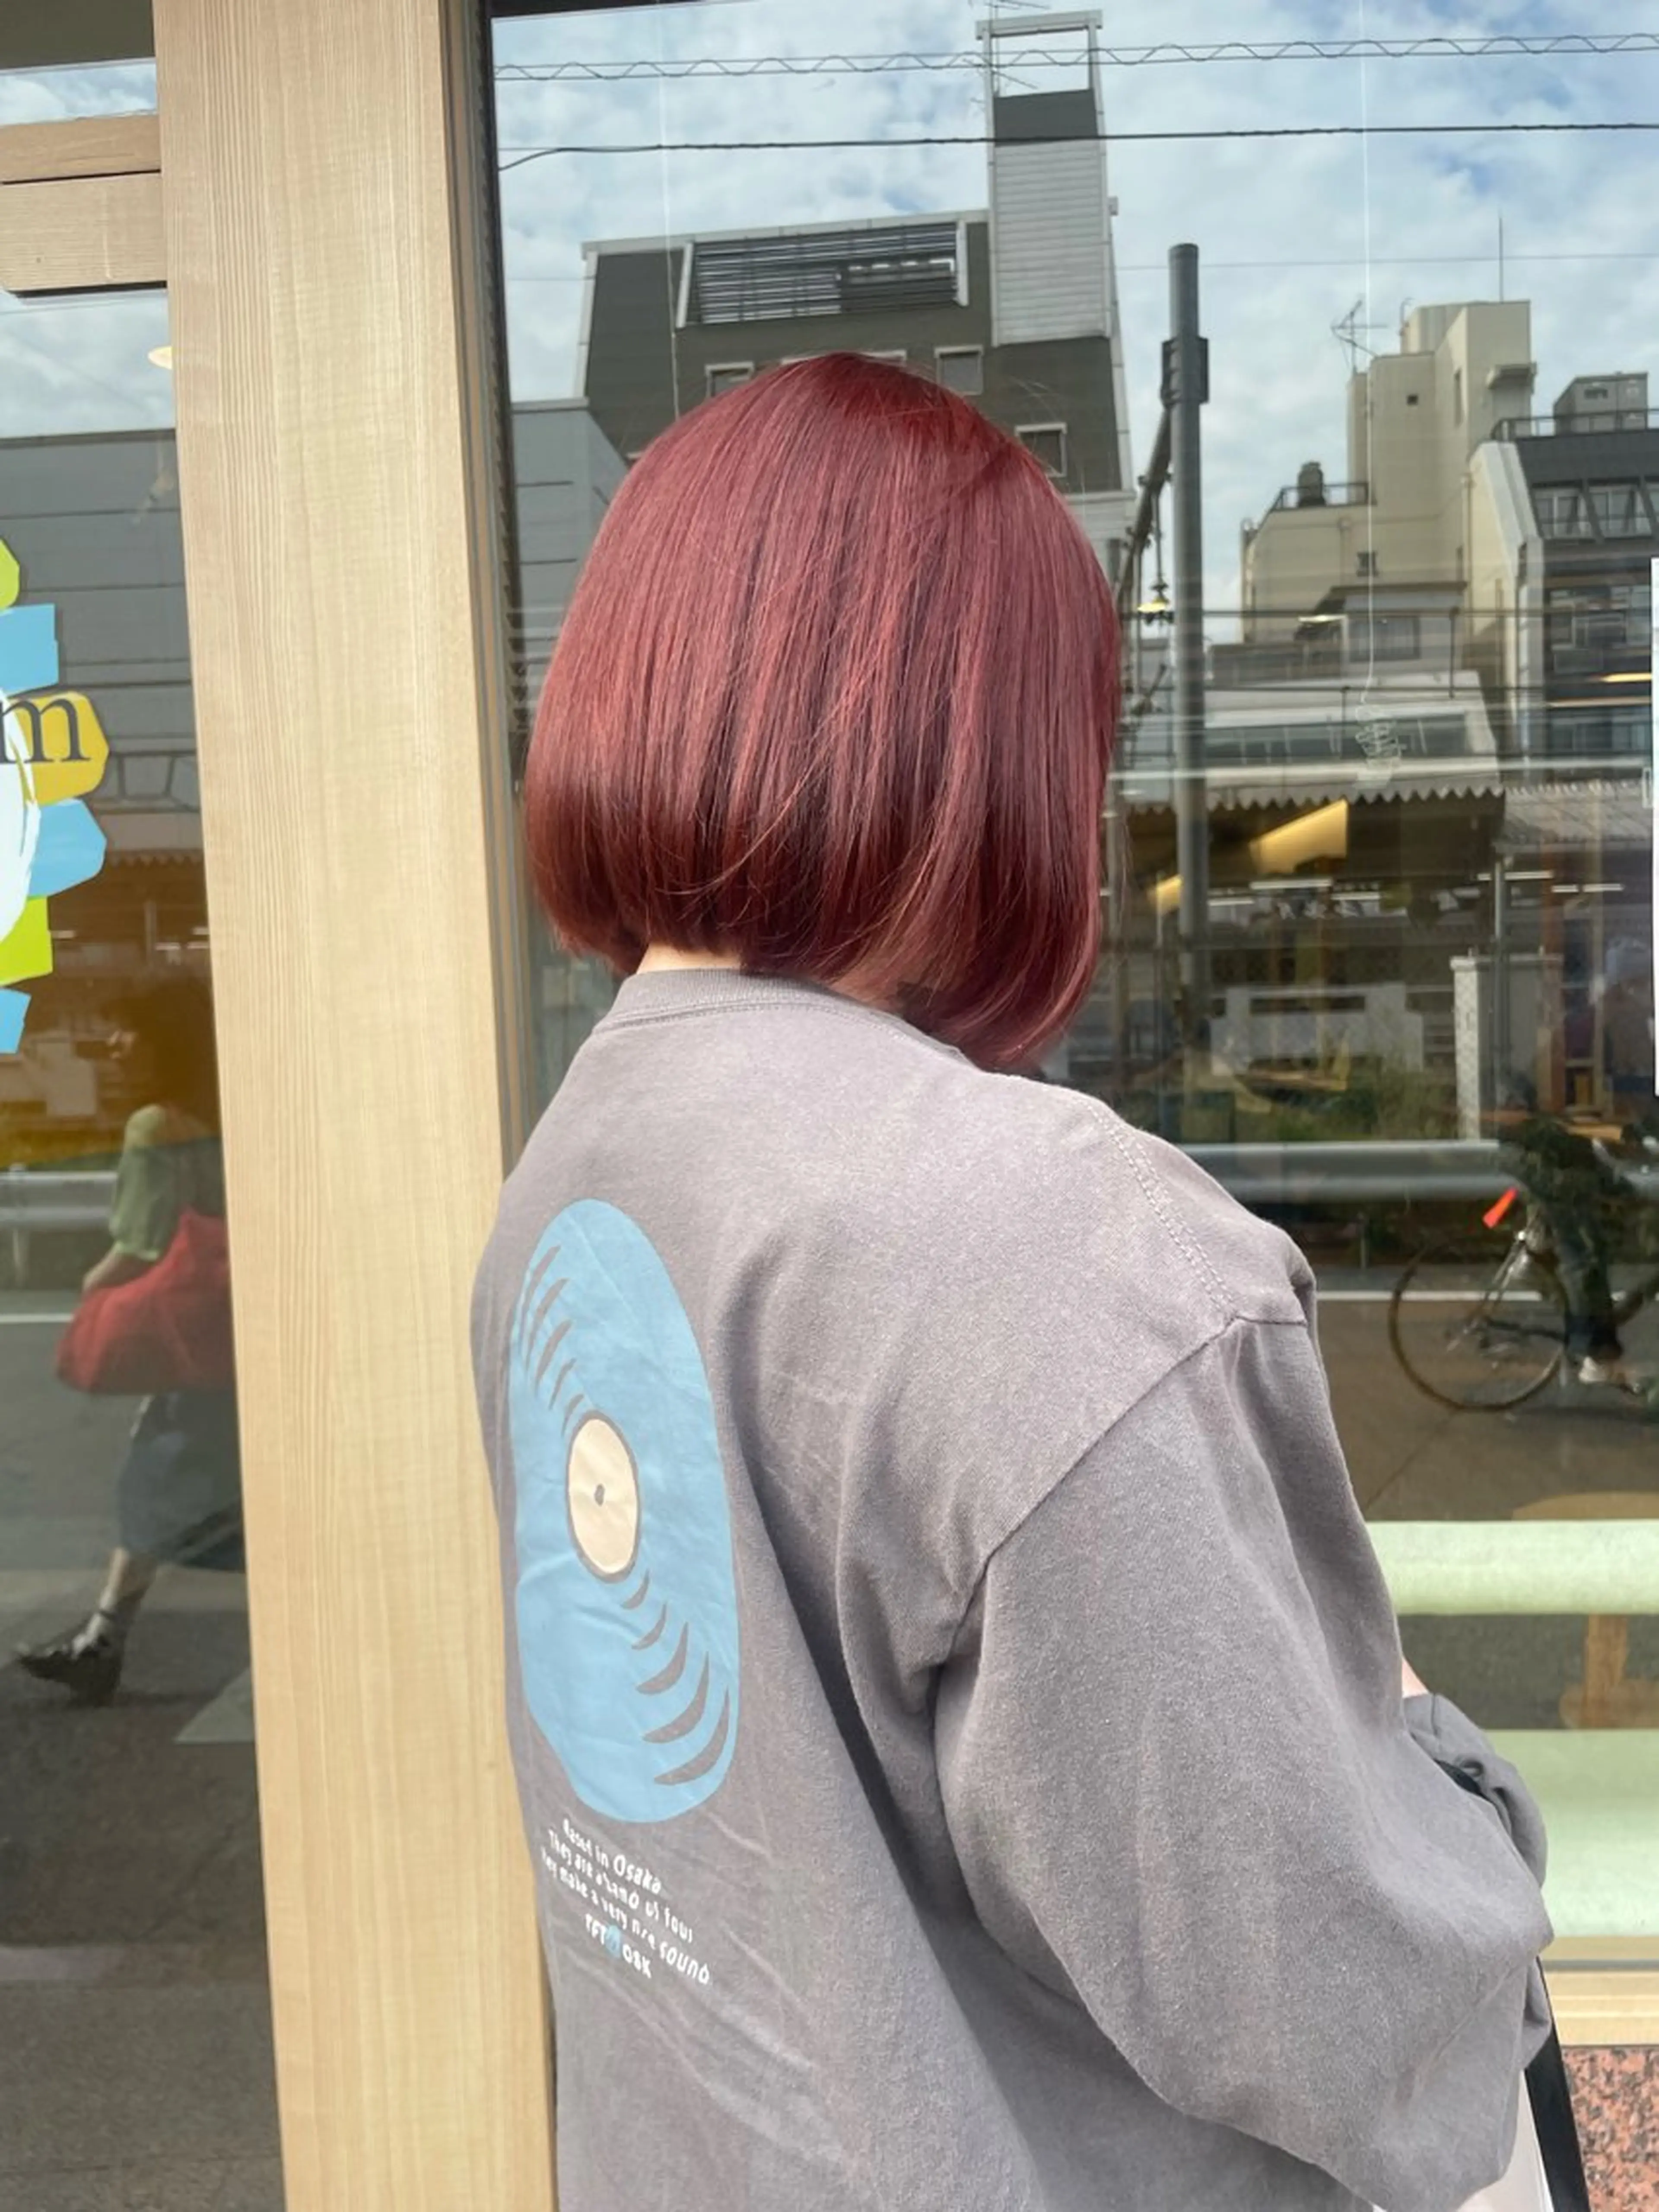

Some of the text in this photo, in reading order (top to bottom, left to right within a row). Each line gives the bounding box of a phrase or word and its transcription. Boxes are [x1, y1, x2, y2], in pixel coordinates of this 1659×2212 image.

[595, 1845, 609, 1869] in
[613, 1854, 661, 1895] Osaka
[601, 1896, 627, 1930] very
[660, 1941, 710, 1984] sound
